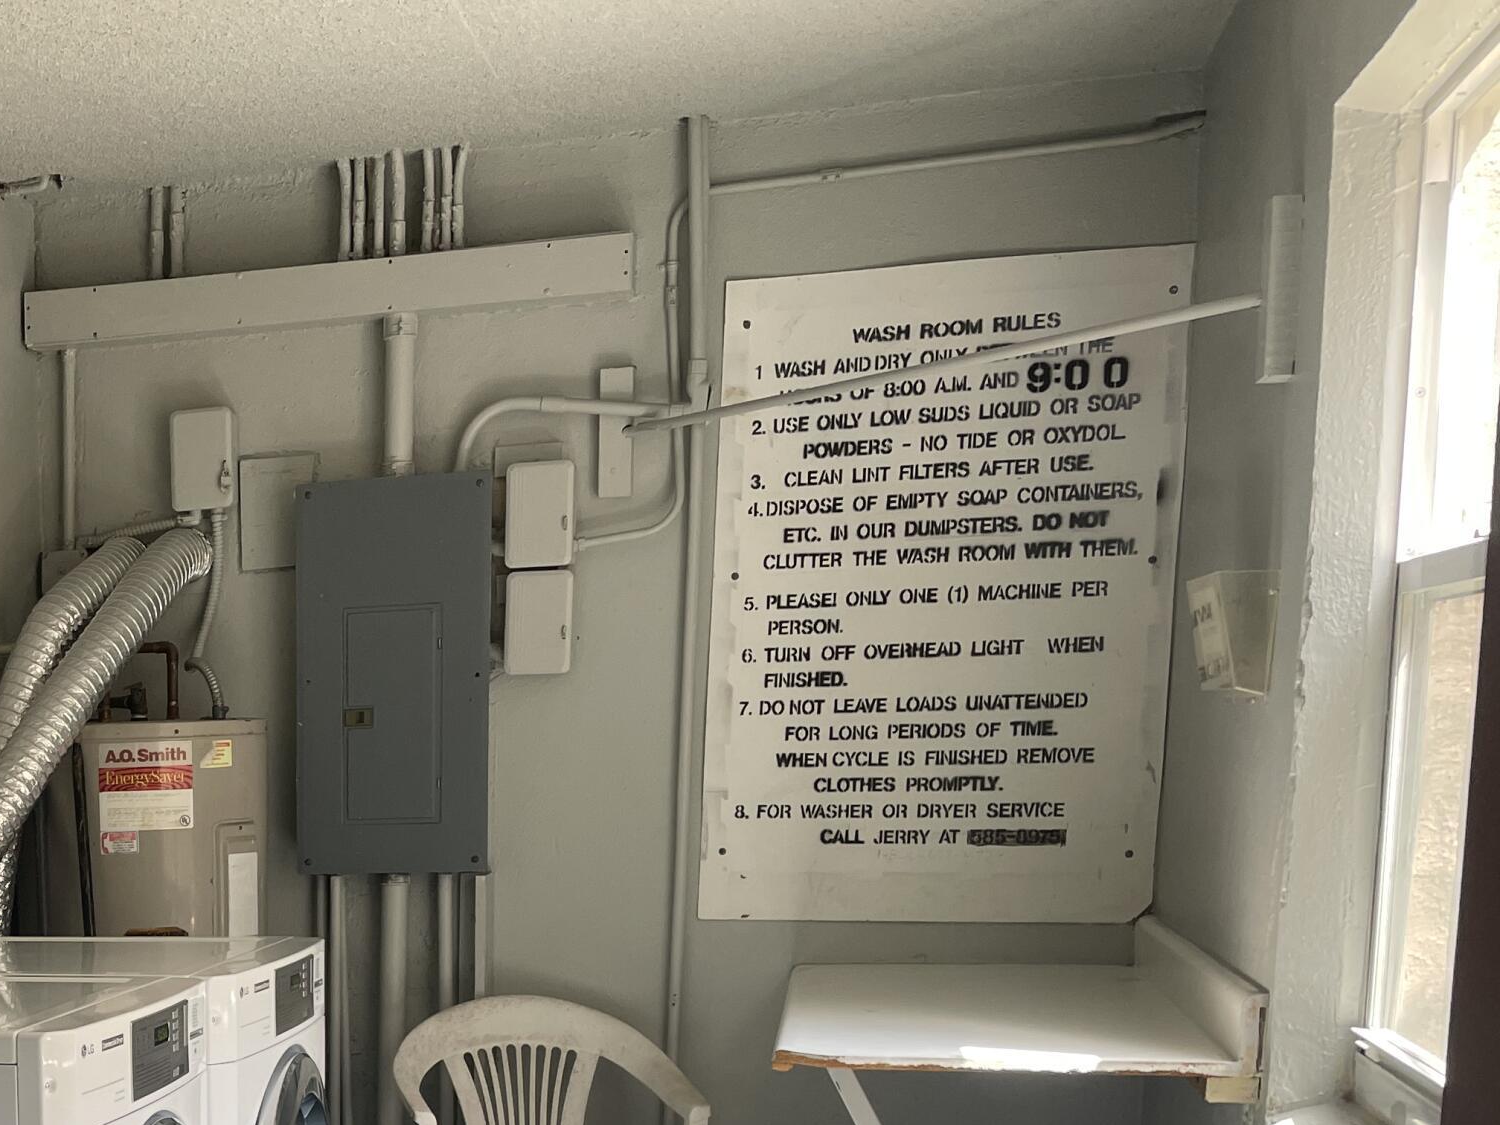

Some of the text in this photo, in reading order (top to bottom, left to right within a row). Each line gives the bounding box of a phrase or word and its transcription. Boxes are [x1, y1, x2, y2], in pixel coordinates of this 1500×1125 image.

[853, 312, 1061, 343] WASH ROOM RULES
[774, 359, 826, 379] WASH
[833, 356, 871, 374] AND
[875, 352, 912, 370] DRY
[883, 379, 926, 398] 8:00
[934, 375, 972, 394] A.M.
[979, 371, 1019, 391] AND
[752, 393, 1142, 436] 2. USE ONLY LOW SUDS LIQUID OR SOAP
[803, 438, 893, 459] POWDERS
[921, 435, 948, 452] NO
[957, 431, 998, 450] TIDE
[1008, 429, 1035, 446] OR
[750, 454, 1094, 490] 3. CLEAN LINT FILTERS AFTER USE.
[743, 596, 758, 611] 5.
[845, 589, 891, 607] ONLY
[899, 587, 938, 605] ONE
[947, 585, 969, 604] (1)
[977, 582, 1062, 602] MACHINE
[1071, 580, 1109, 597] PER
[768, 619, 843, 636] PERSON.
[741, 636, 1105, 664] 6. TURN OFF OVERHEAD LIGHT WHEN
[764, 671, 848, 688] FINISHED.
[739, 692, 1088, 716] 7. DO NOT LEAVE LOADS UNATTENDED
[784, 720, 1058, 742] FOR LONG PERIODS OF TIME.
[105, 747, 187, 764] A.O. Smith
[734, 802, 1065, 820] 8. FOR WASHER OR DRYER SERVICE
[820, 829, 865, 845] CALL
[873, 829, 930, 845] JERRY
[938, 829, 960, 844] AT
